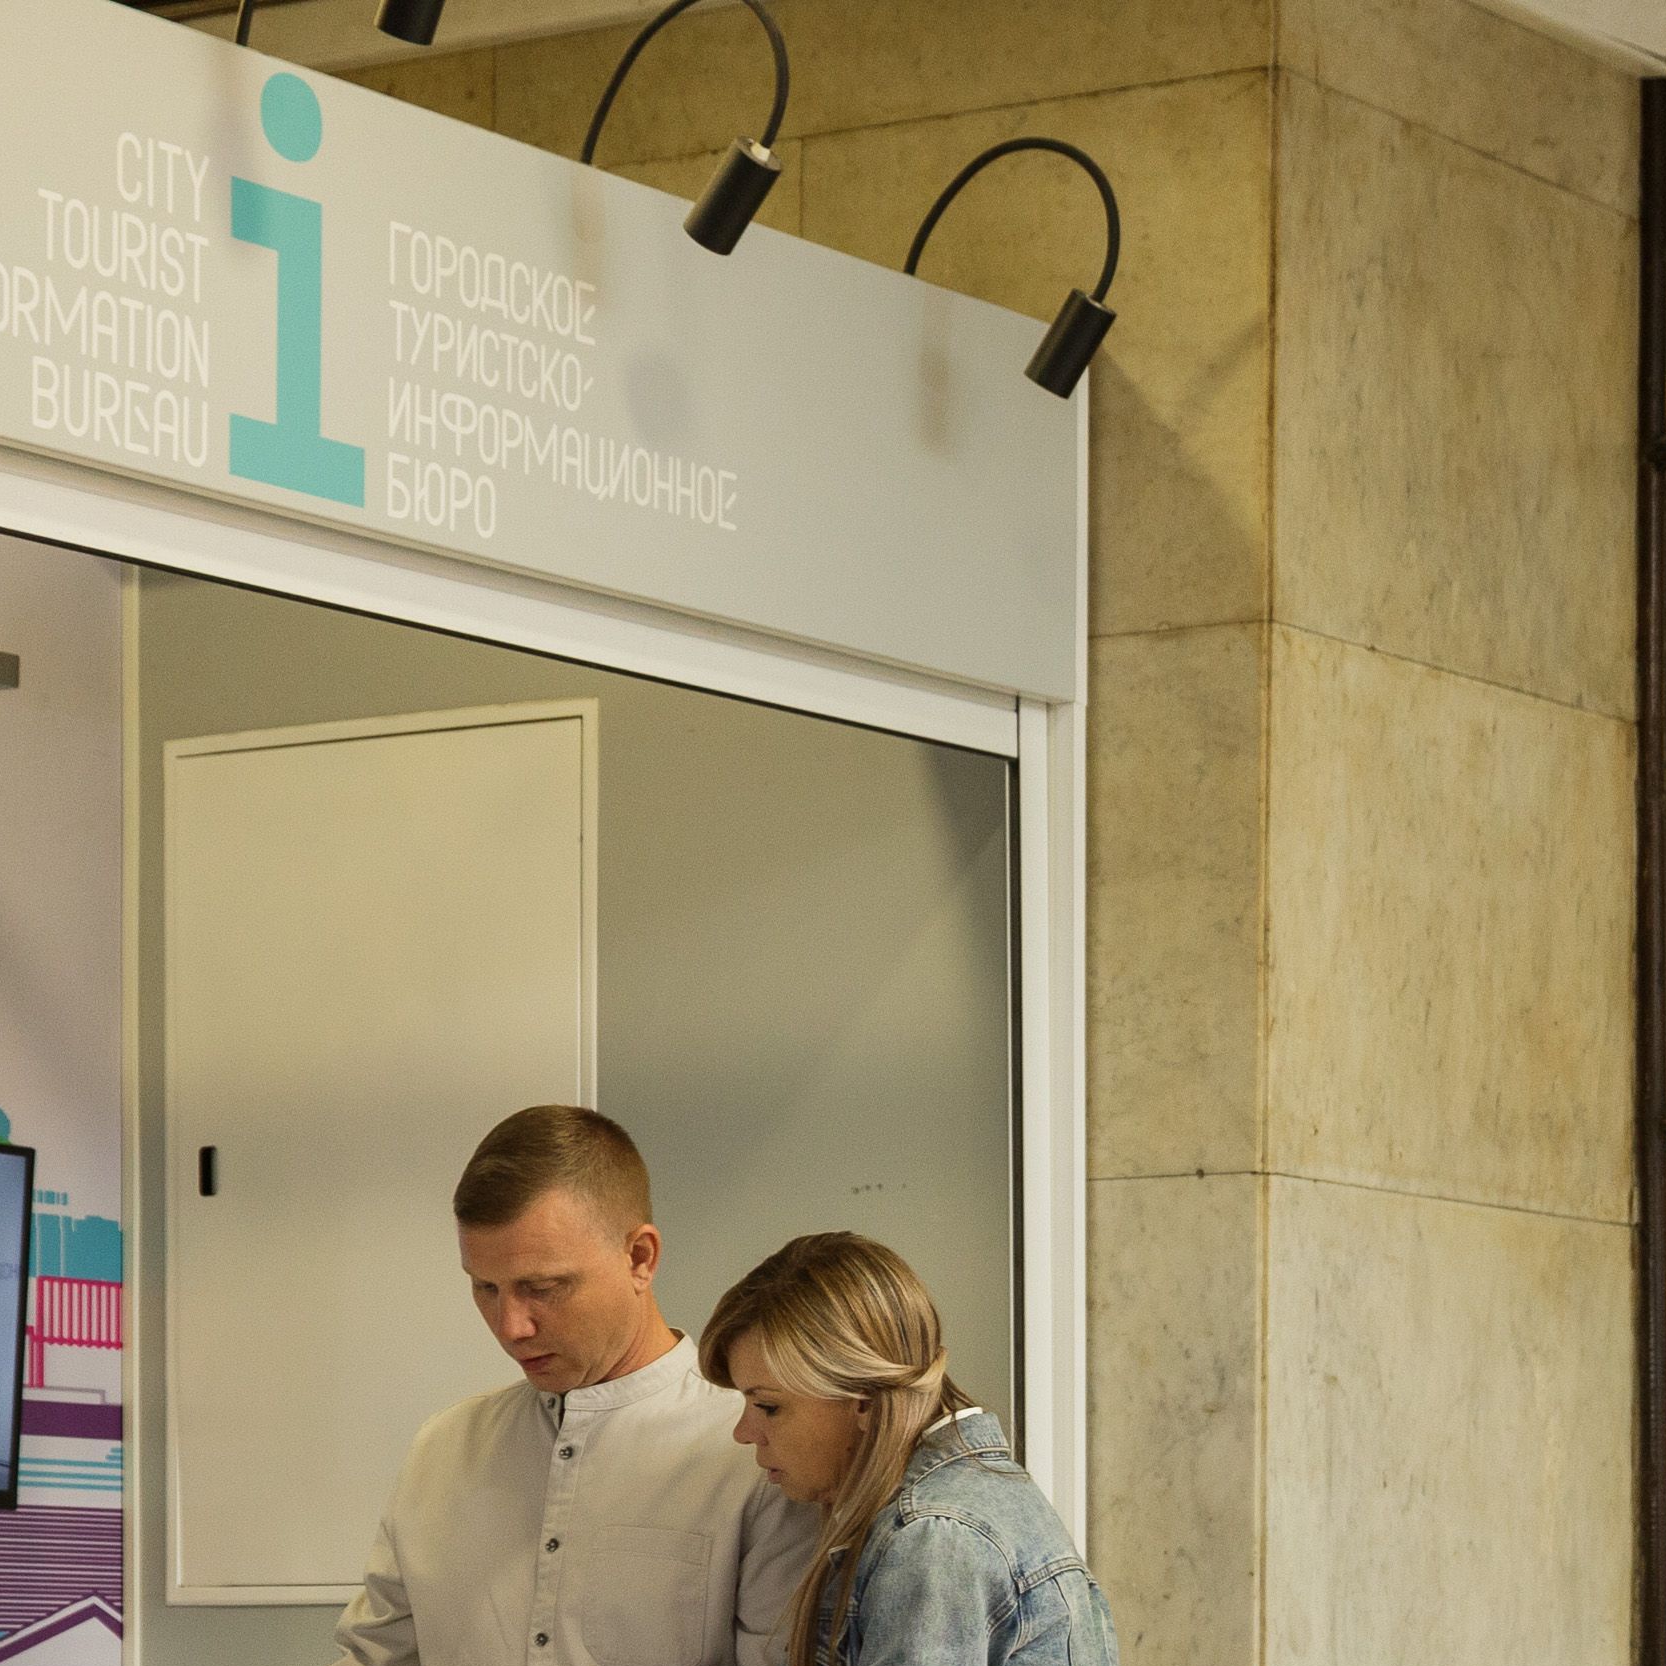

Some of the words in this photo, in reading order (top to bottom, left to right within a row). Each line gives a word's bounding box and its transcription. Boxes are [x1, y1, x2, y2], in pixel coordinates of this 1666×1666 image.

[116, 132, 209, 222] CITY
[37, 187, 209, 303] TOURIST
[389, 220, 596, 346] ГОРОДСКОЕ
[31, 355, 209, 468] BUREAU
[388, 376, 738, 532] ИНФОРМАЦИОННОЕ
[387, 451, 496, 538] БЮРО
